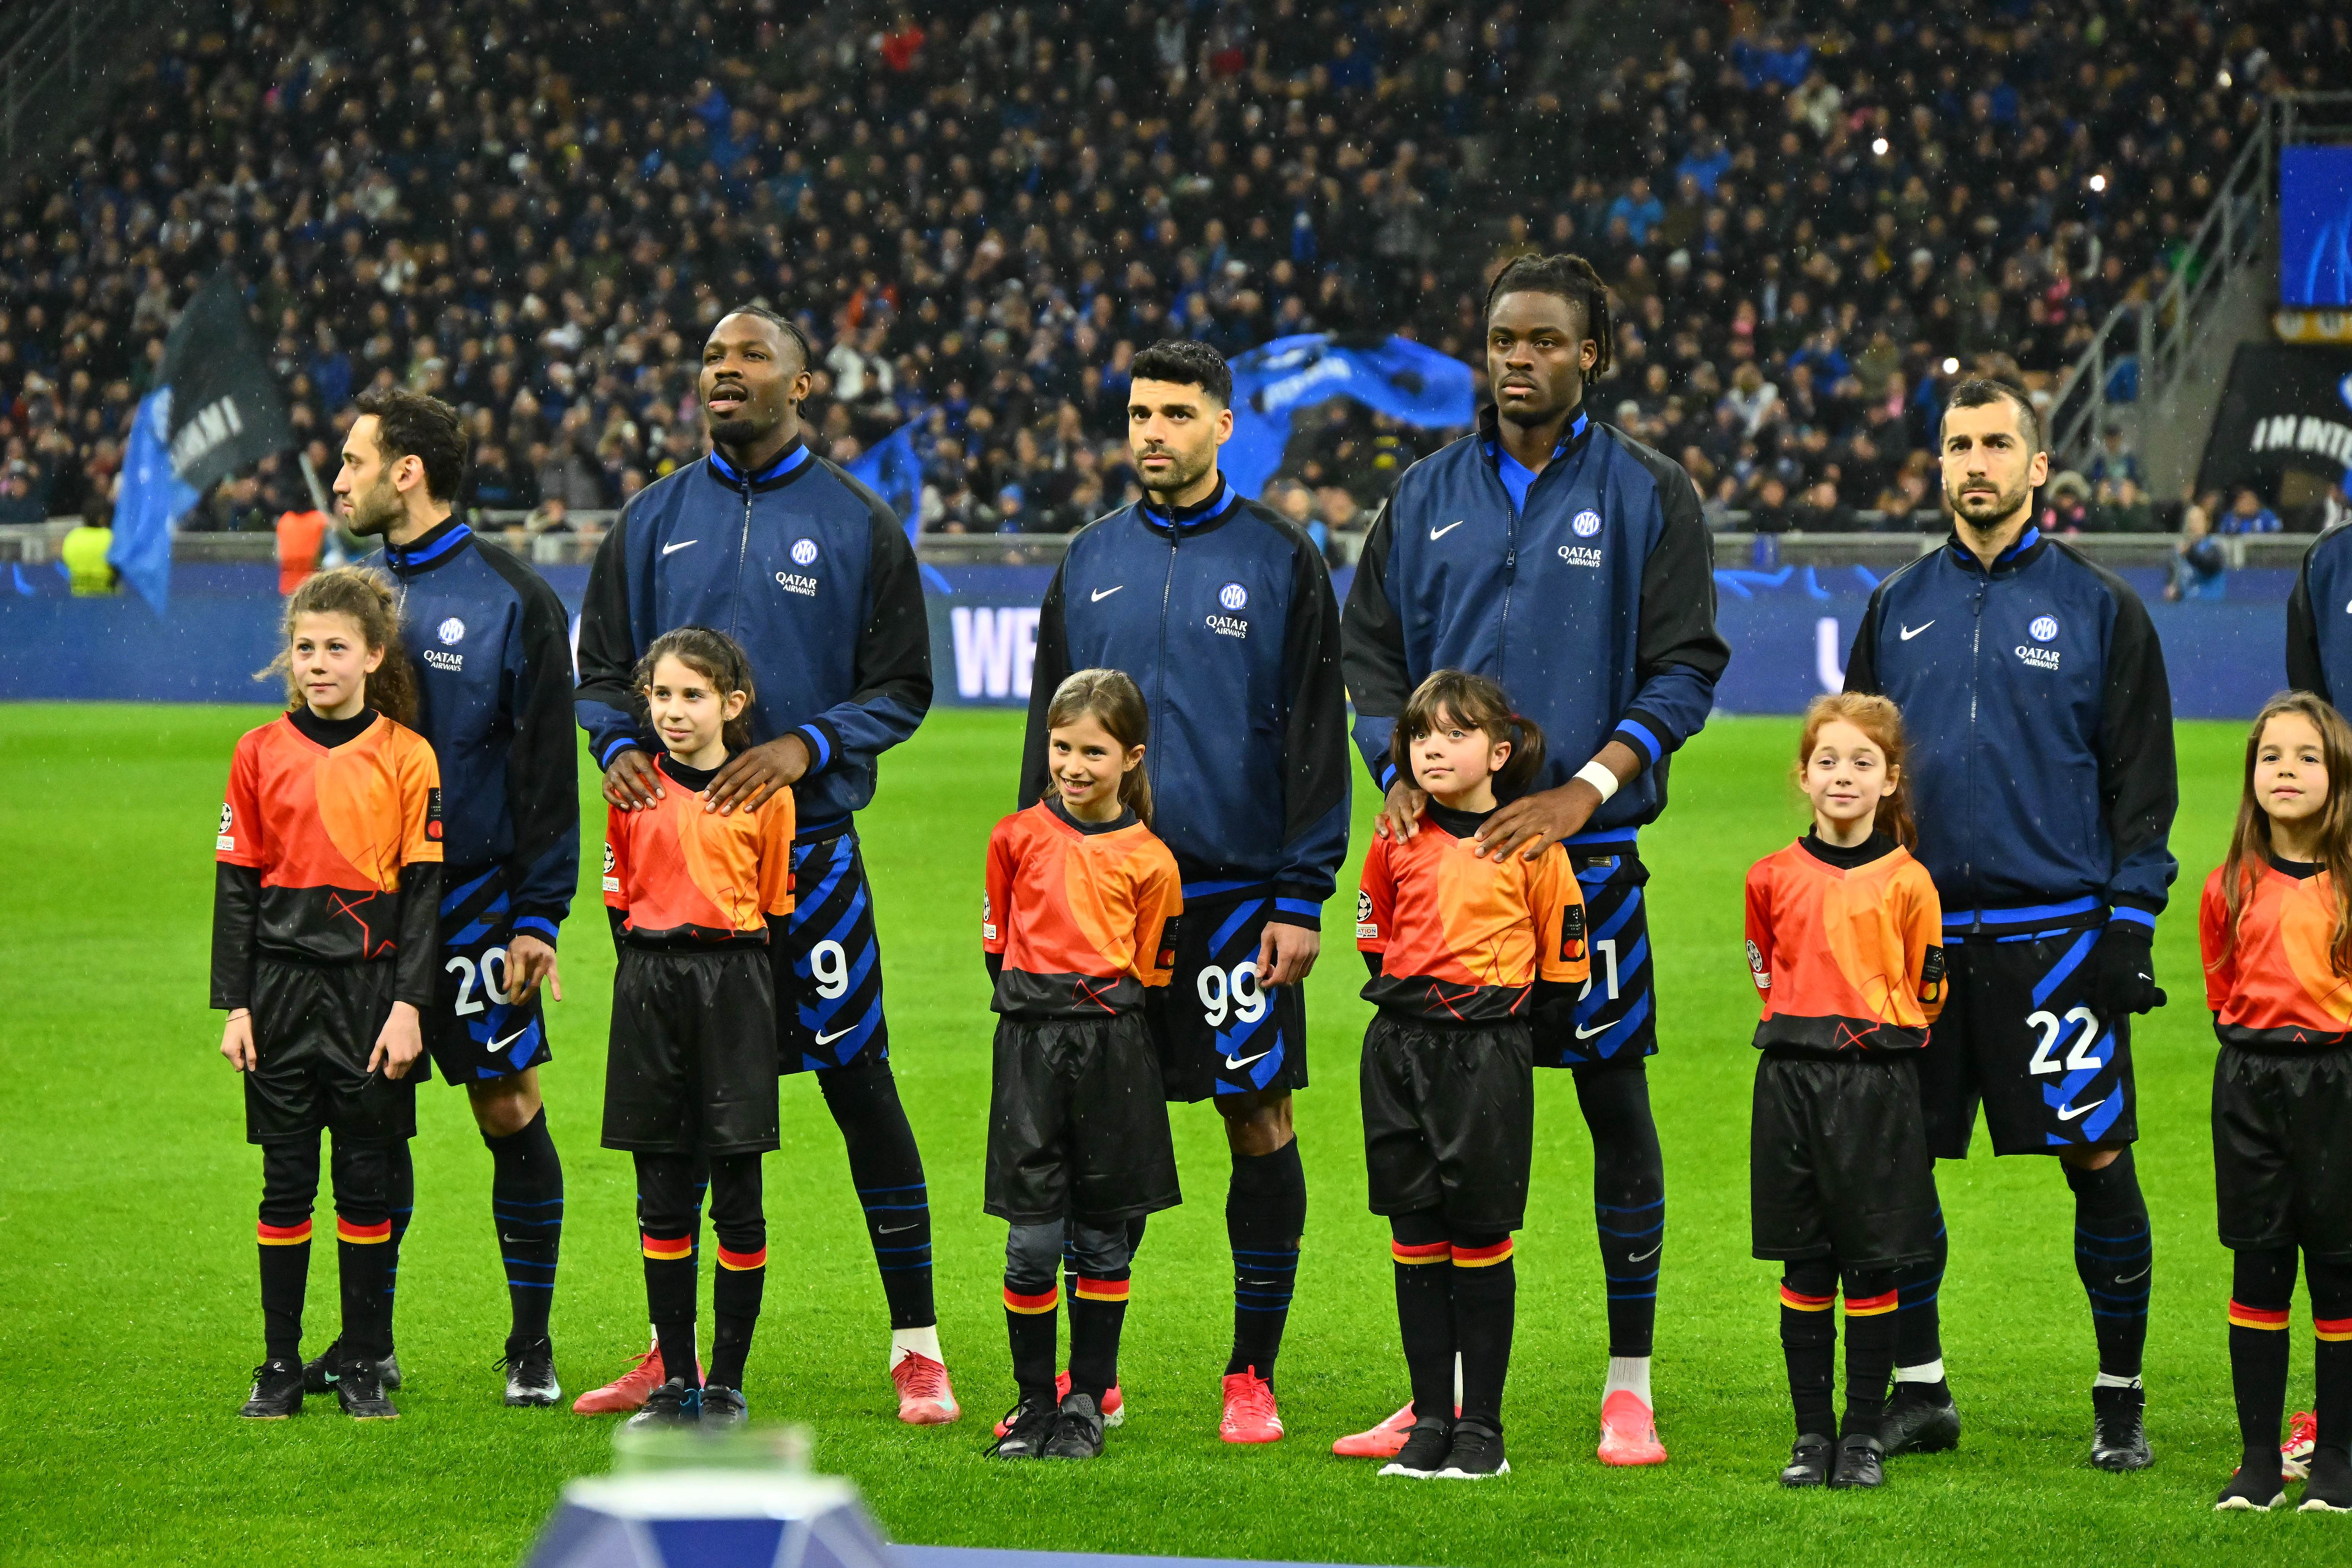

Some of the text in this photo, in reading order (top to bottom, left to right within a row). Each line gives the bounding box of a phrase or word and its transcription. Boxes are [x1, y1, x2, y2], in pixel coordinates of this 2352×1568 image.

[1558, 546, 1601, 560] QATAR
[1567, 557, 1600, 567] AIRWAYS
[775, 572, 817, 589] QATAR
[782, 584, 816, 596] AIRWAYS
[1206, 615, 1247, 632] QATAR
[1215, 627, 1246, 639] AIRWAYS
[424, 650, 463, 665] QATAR
[2015, 646, 2060, 662] QATAR
[430, 661, 462, 671] AIRWAYS
[2023, 658, 2059, 670] AIRWAYS
[810, 940, 848, 999] 9
[1577, 939, 1619, 1002] 1
[445, 947, 511, 1016] 20
[1197, 961, 1266, 1027] 99
[2026, 1007, 2102, 1075] 22
